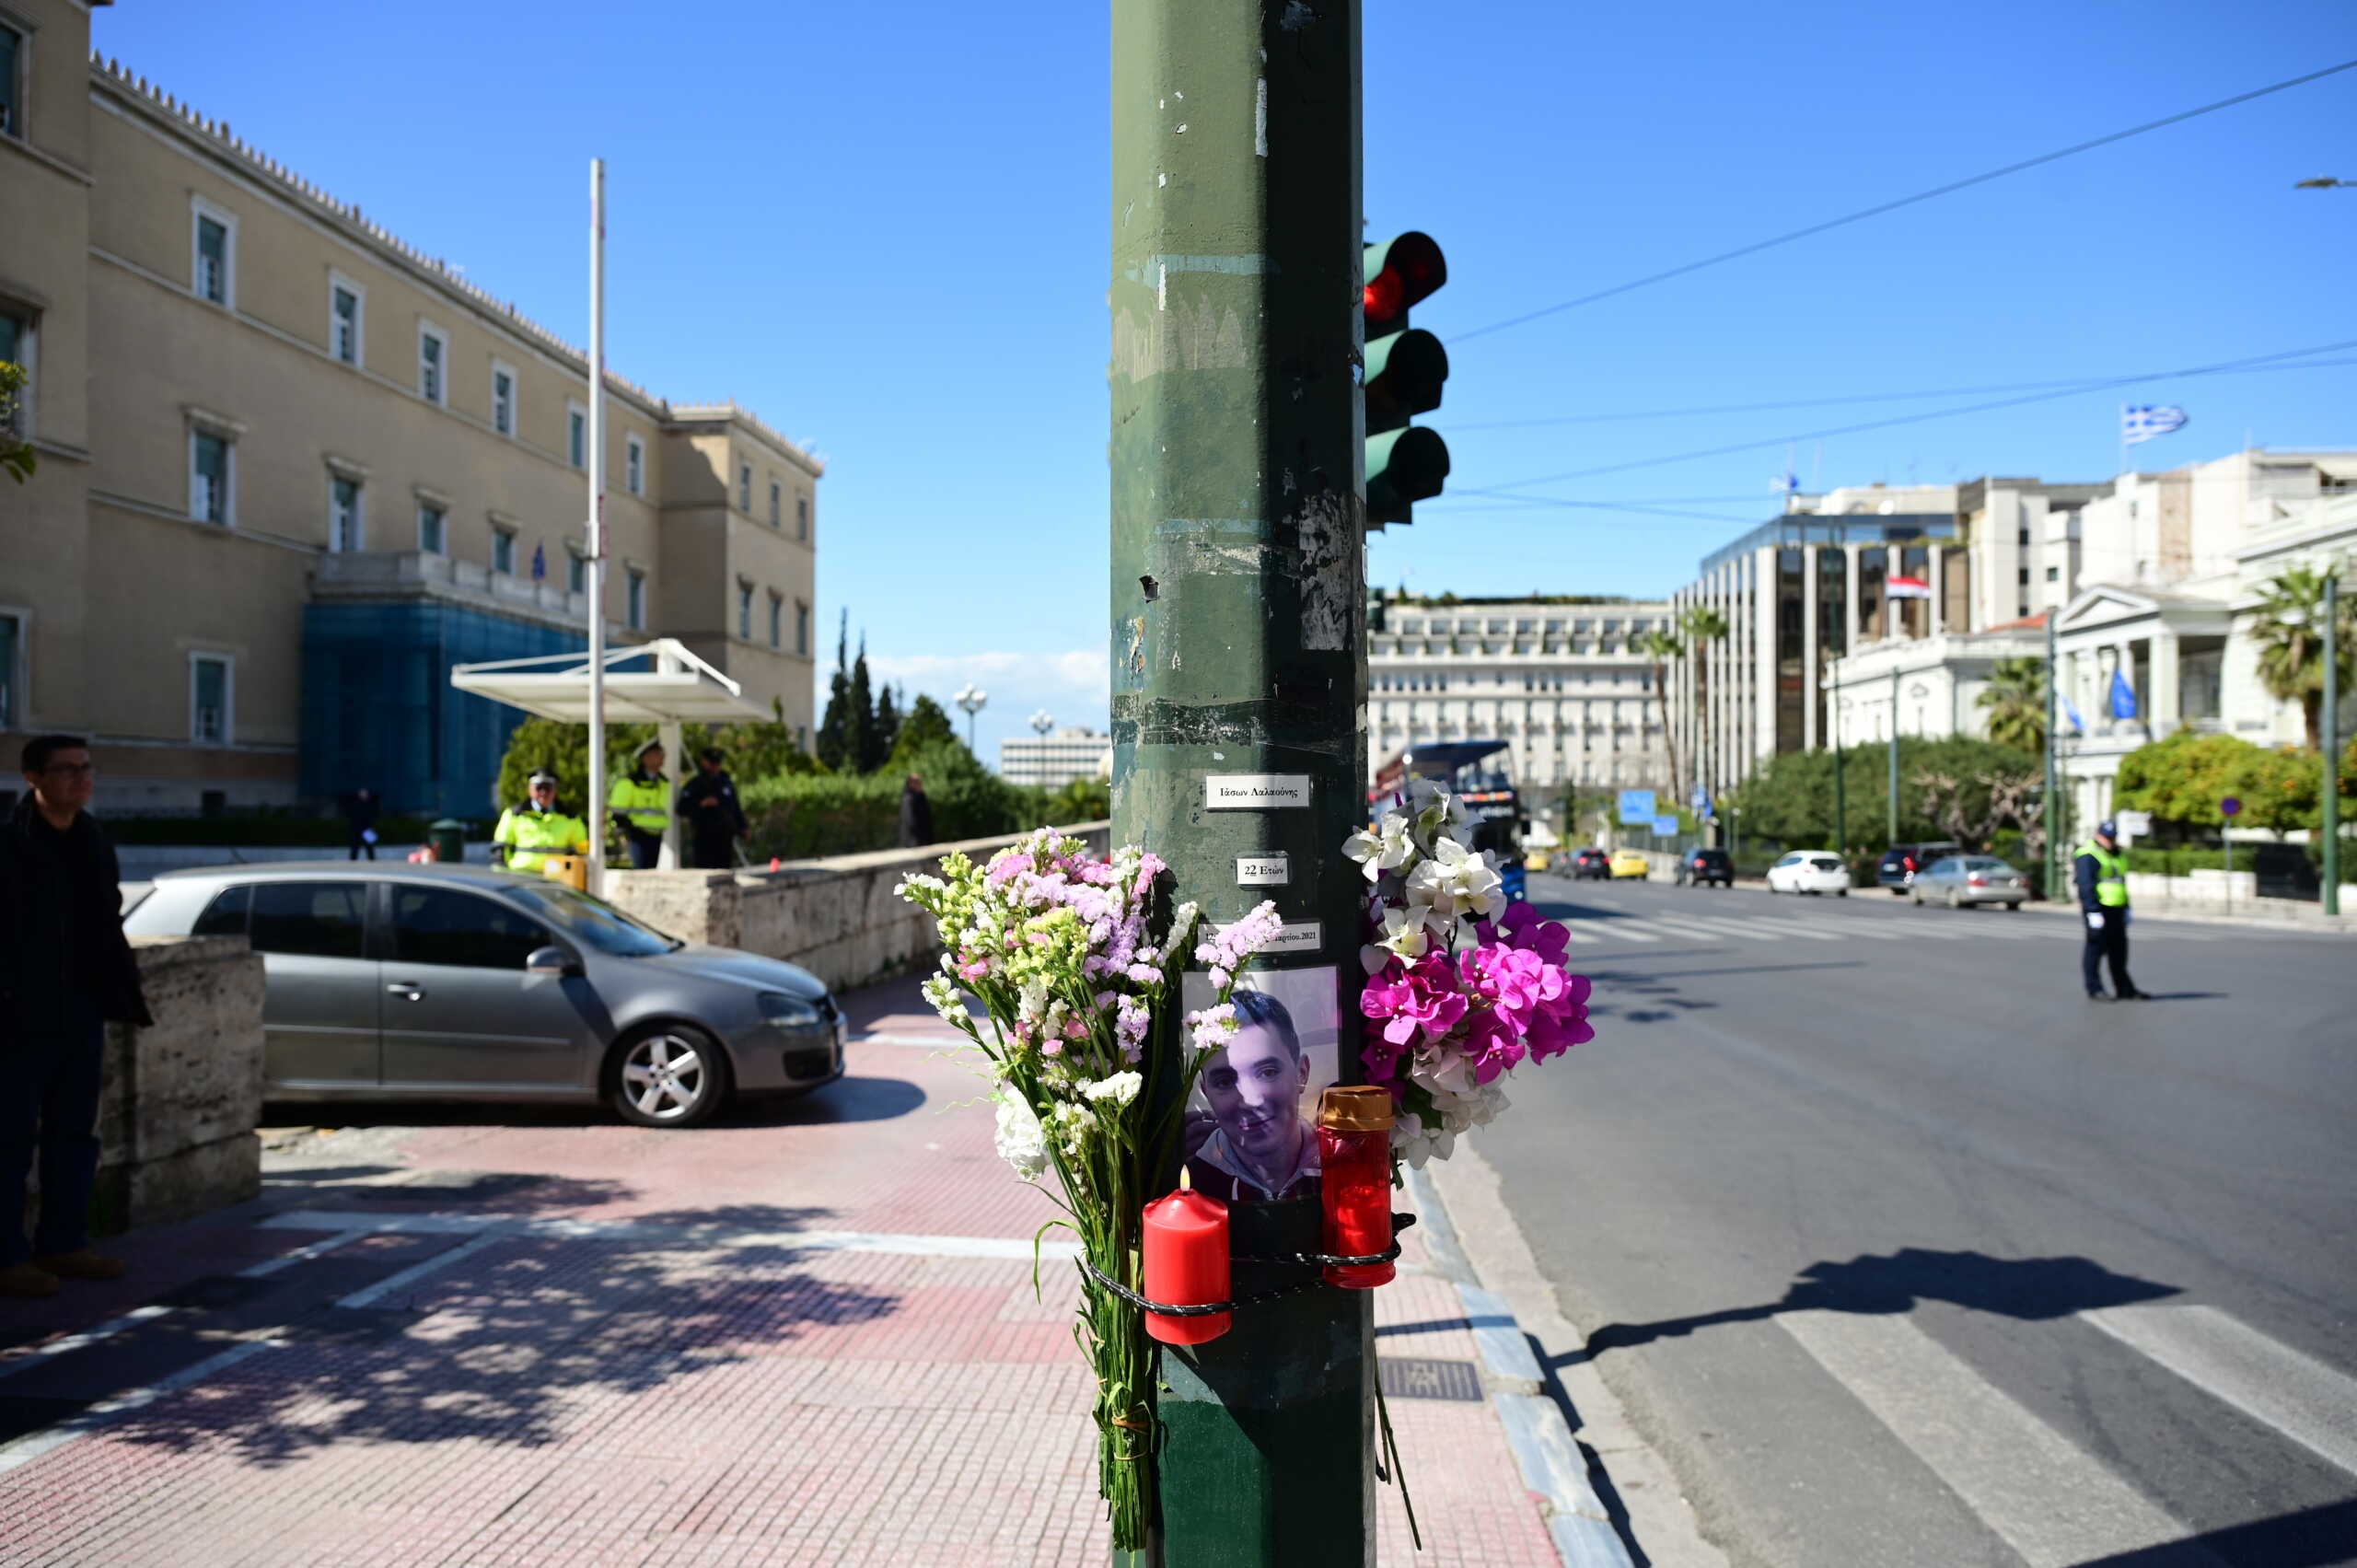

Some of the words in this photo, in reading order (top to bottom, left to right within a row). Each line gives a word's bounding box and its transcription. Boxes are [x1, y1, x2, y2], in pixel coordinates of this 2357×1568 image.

[1220, 787, 1248, 796] Ιάσων
[1250, 786, 1299, 798] Λαλαούνης
[1244, 864, 1257, 875] 22
[1260, 865, 1283, 875] Ετών
